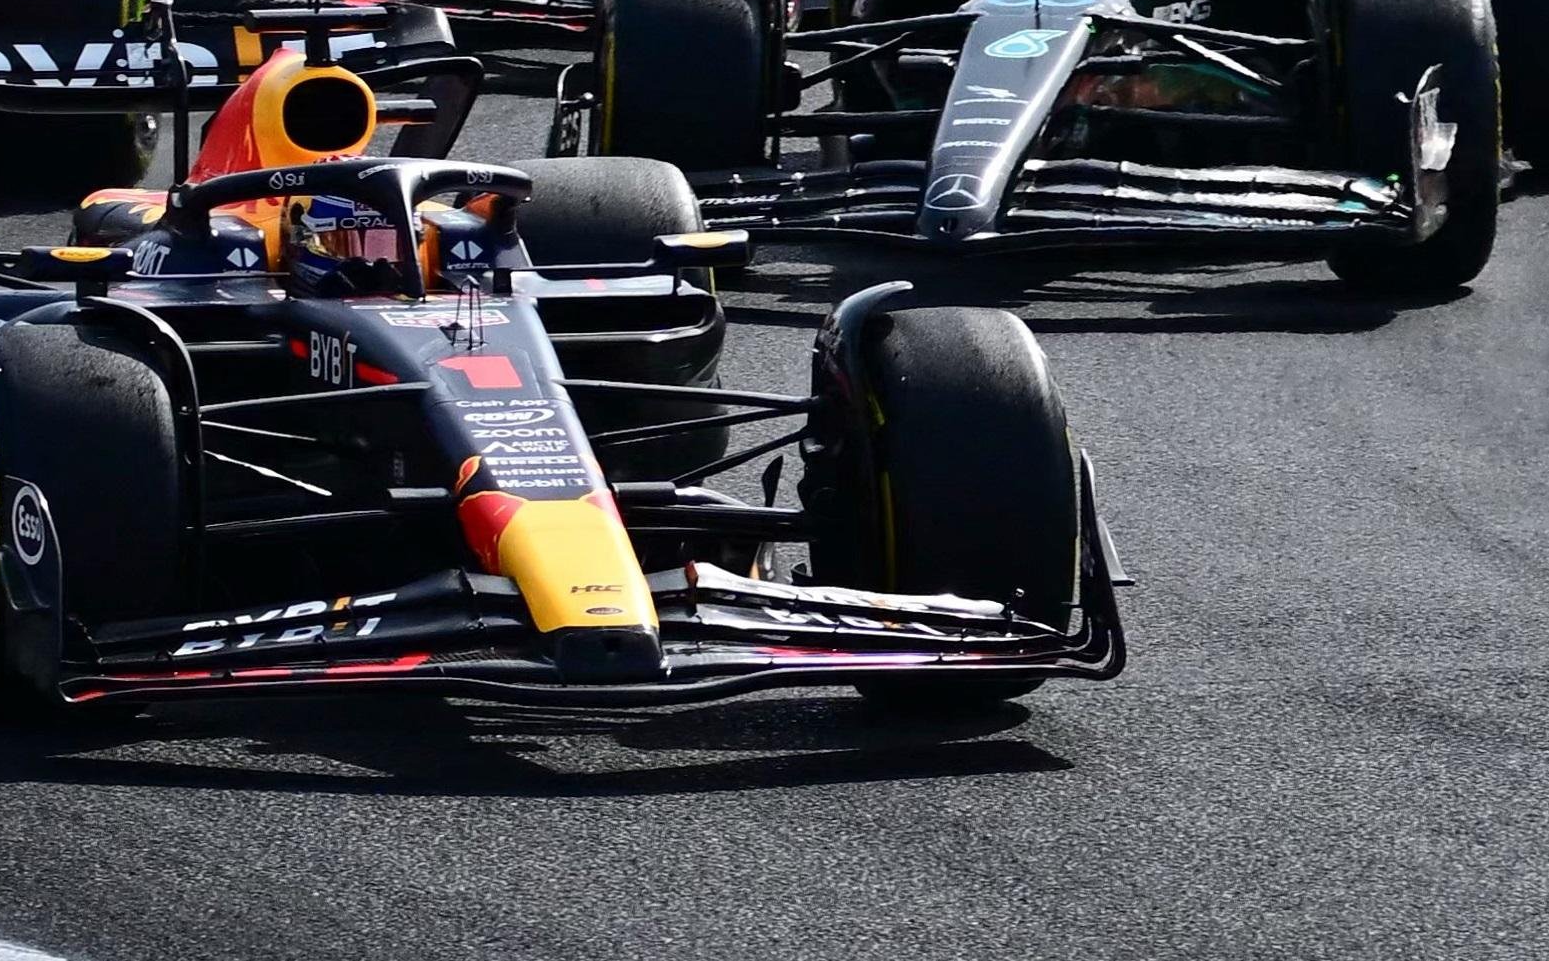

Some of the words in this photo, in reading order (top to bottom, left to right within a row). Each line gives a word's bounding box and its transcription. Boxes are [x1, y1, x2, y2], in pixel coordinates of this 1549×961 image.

[310, 330, 358, 389] BYBIT
[436, 355, 523, 389] 1
[456, 399, 505, 408] Cash
[509, 399, 550, 408] App
[464, 410, 539, 424] CDW
[471, 427, 566, 439] zoom
[512, 440, 570, 448] ARCTIC
[497, 478, 565, 488] Mobil
[570, 584, 623, 593] HRC
